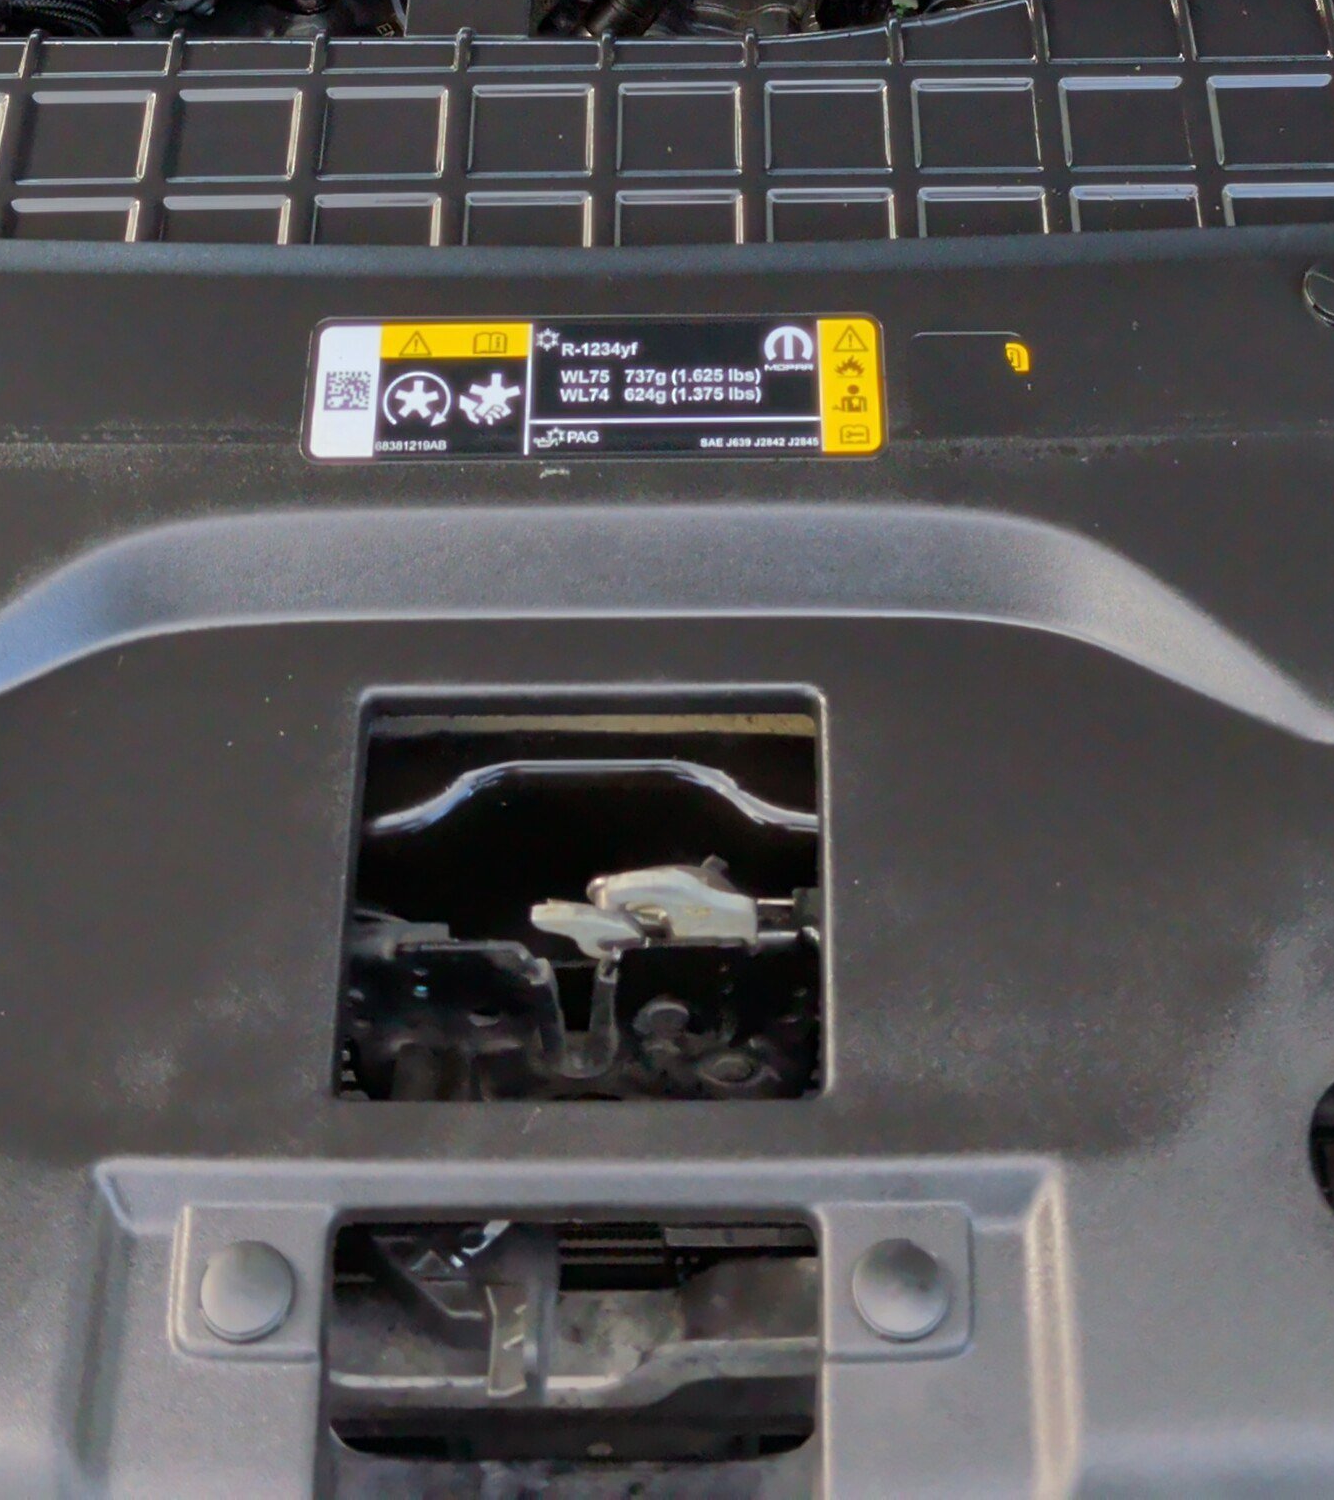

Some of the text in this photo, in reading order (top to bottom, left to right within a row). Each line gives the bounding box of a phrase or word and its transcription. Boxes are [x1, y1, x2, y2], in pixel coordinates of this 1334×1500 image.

[561, 341, 639, 359] R-1234yf
[764, 363, 814, 372] MOPAR
[560, 368, 762, 386] WL75 737g (1.625 lbs)
[560, 386, 762, 404] WL74 624g (1.375 lbs)
[566, 430, 600, 444] PAG
[699, 437, 724, 448] SAE
[726, 437, 752, 448] J639
[754, 437, 786, 447] J2842
